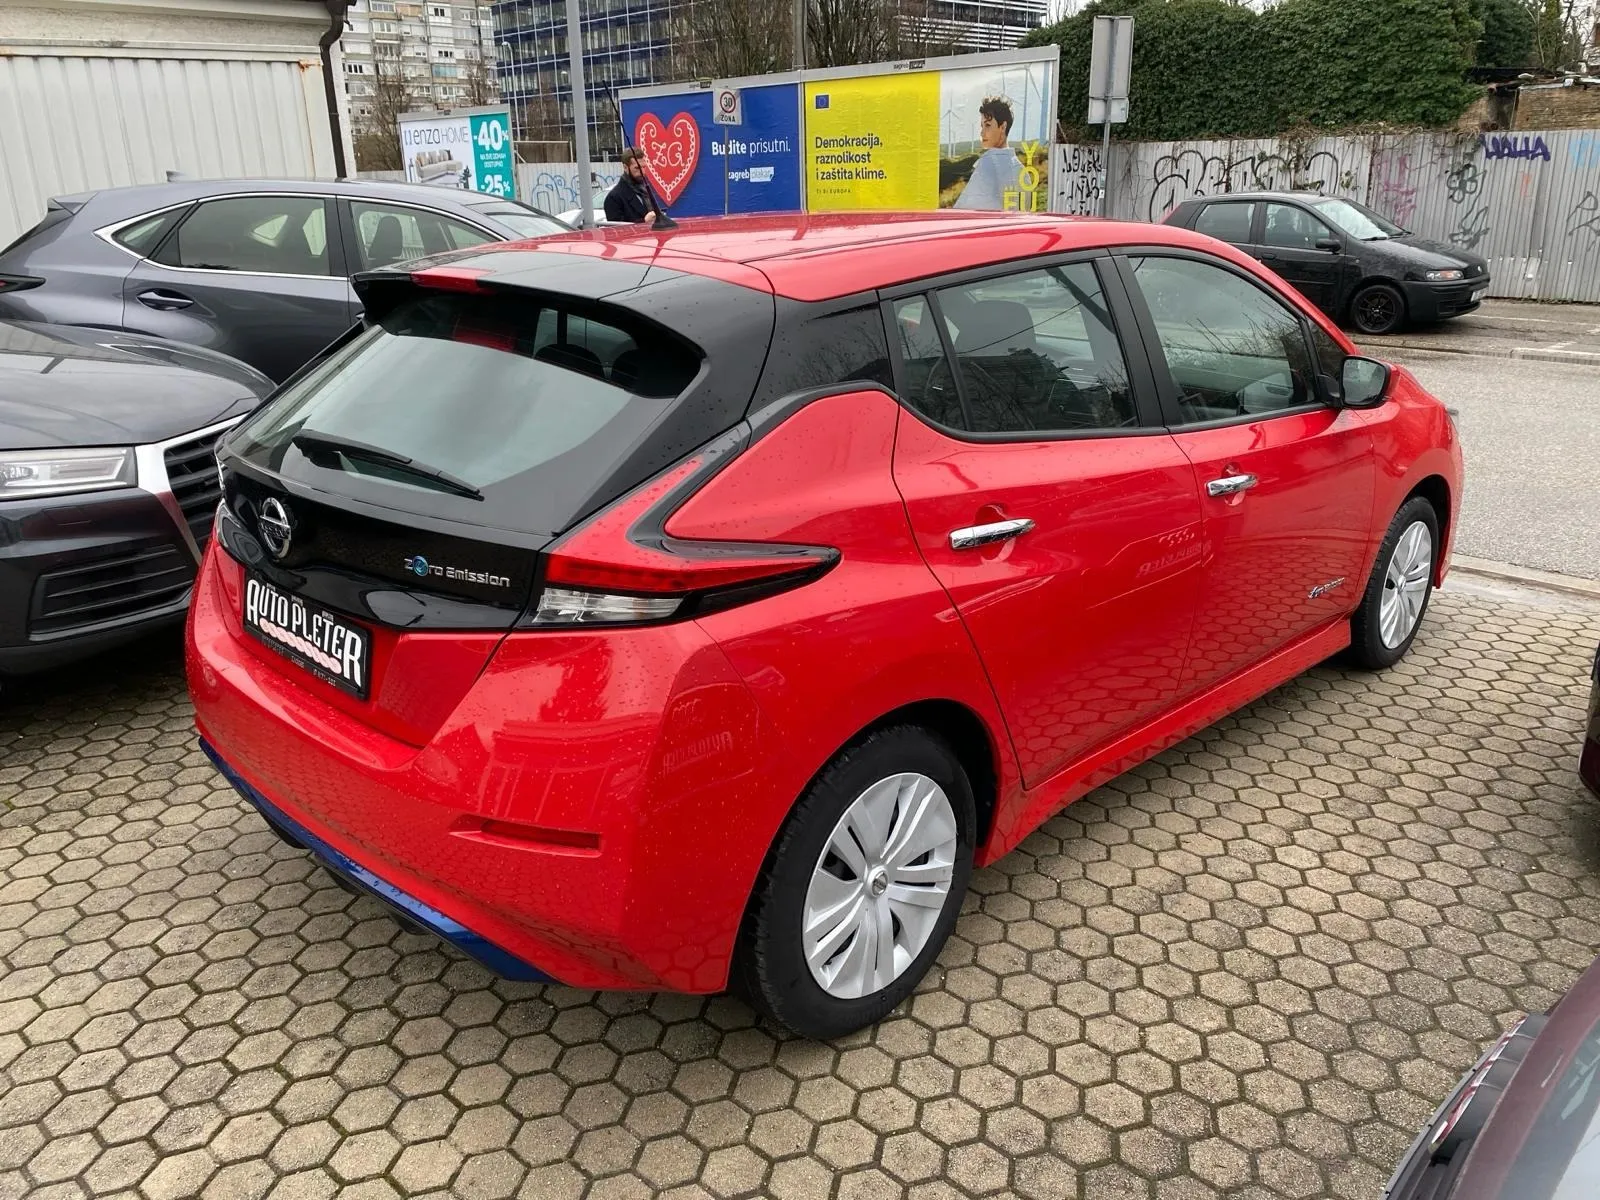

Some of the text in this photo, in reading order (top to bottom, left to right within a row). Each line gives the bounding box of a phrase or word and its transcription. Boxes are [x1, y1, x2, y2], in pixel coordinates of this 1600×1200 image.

[723, 97, 733, 108] 30
[720, 114, 736, 122] ZONA
[711, 136, 791, 158] Budite prisutni.
[815, 133, 883, 149] Demokracija,
[815, 151, 871, 165] raznolikost
[820, 167, 853, 180] zaštita
[855, 167, 887, 180] klime.
[246, 579, 362, 687] AUTO PLETER
